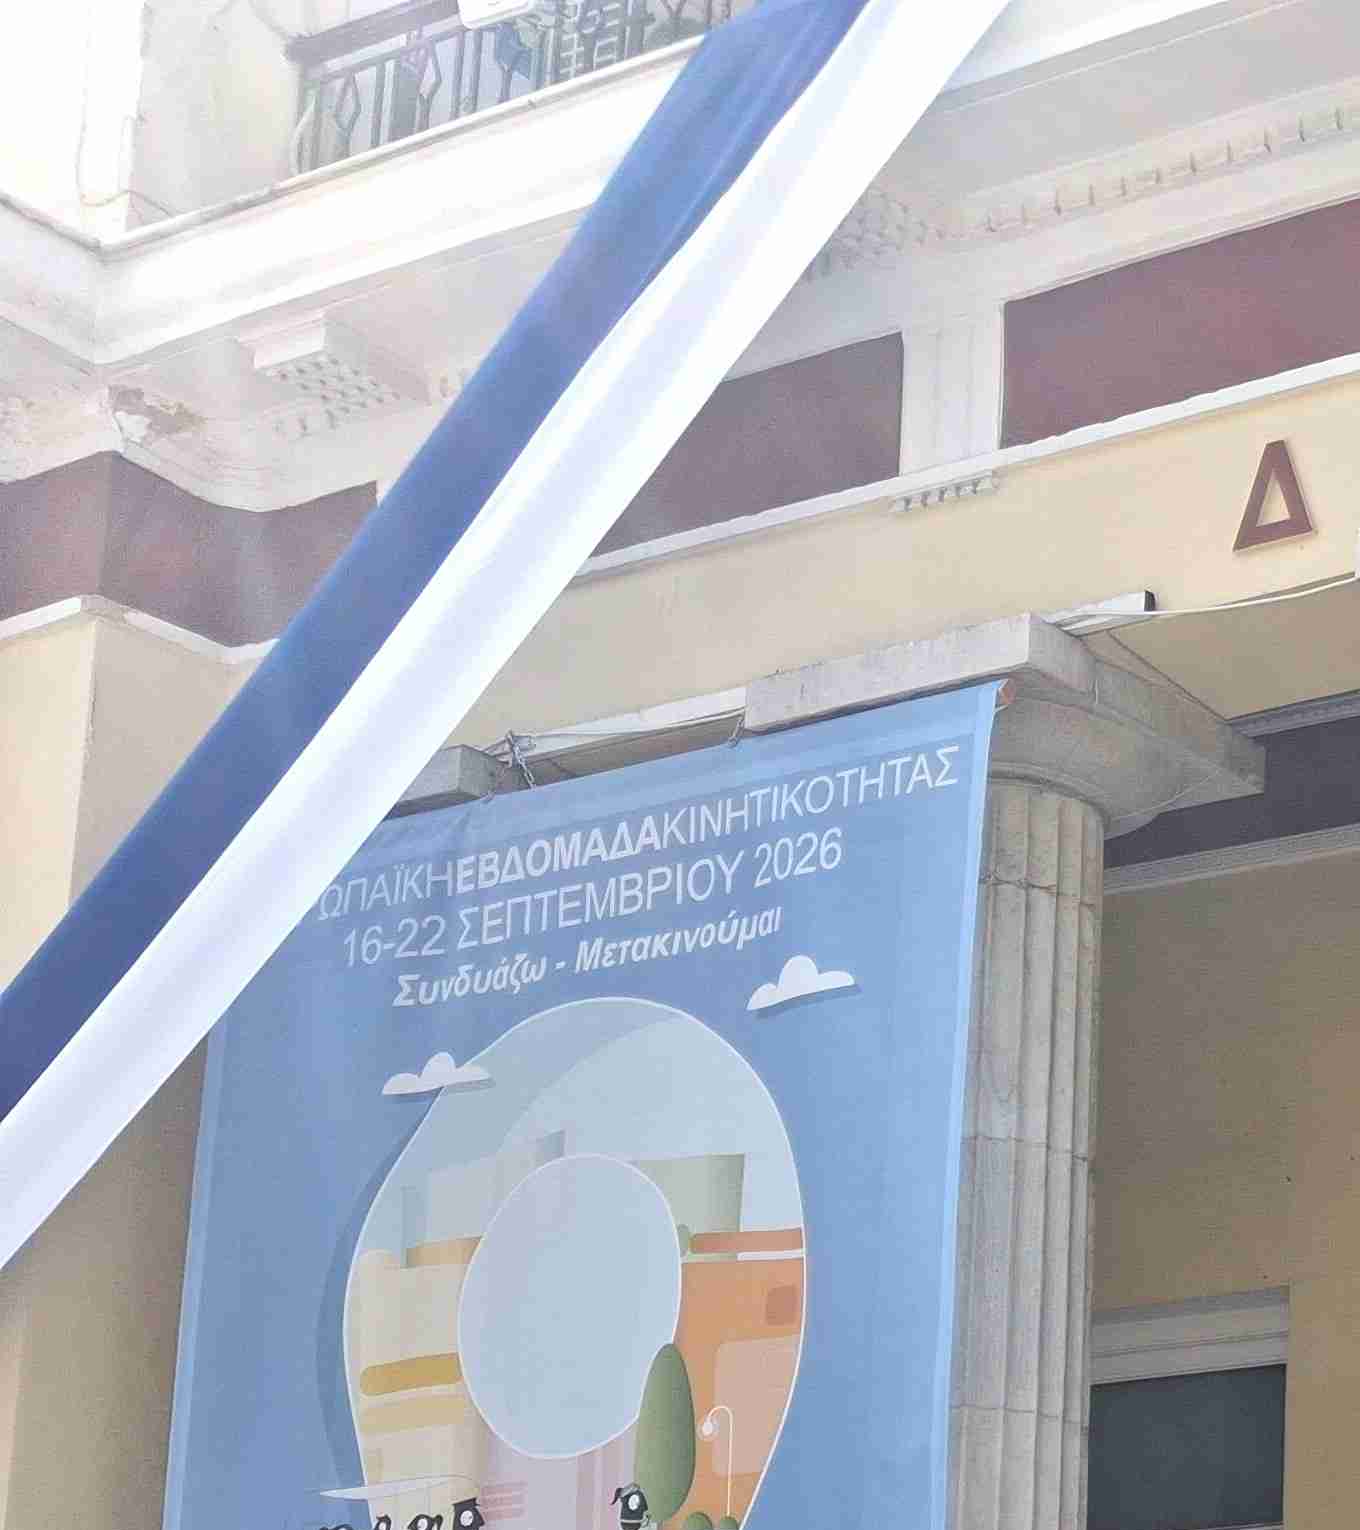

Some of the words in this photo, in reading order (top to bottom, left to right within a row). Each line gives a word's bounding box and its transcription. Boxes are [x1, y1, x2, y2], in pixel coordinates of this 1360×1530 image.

[343, 914, 447, 968] 16-22
[455, 850, 745, 952] ΣΕΠΤΕΜΒΡΙΟΥ
[753, 826, 843, 889] 2026
[391, 953, 547, 1008] Συνδυάζω
[575, 906, 783, 975] Μετακινούμαι
